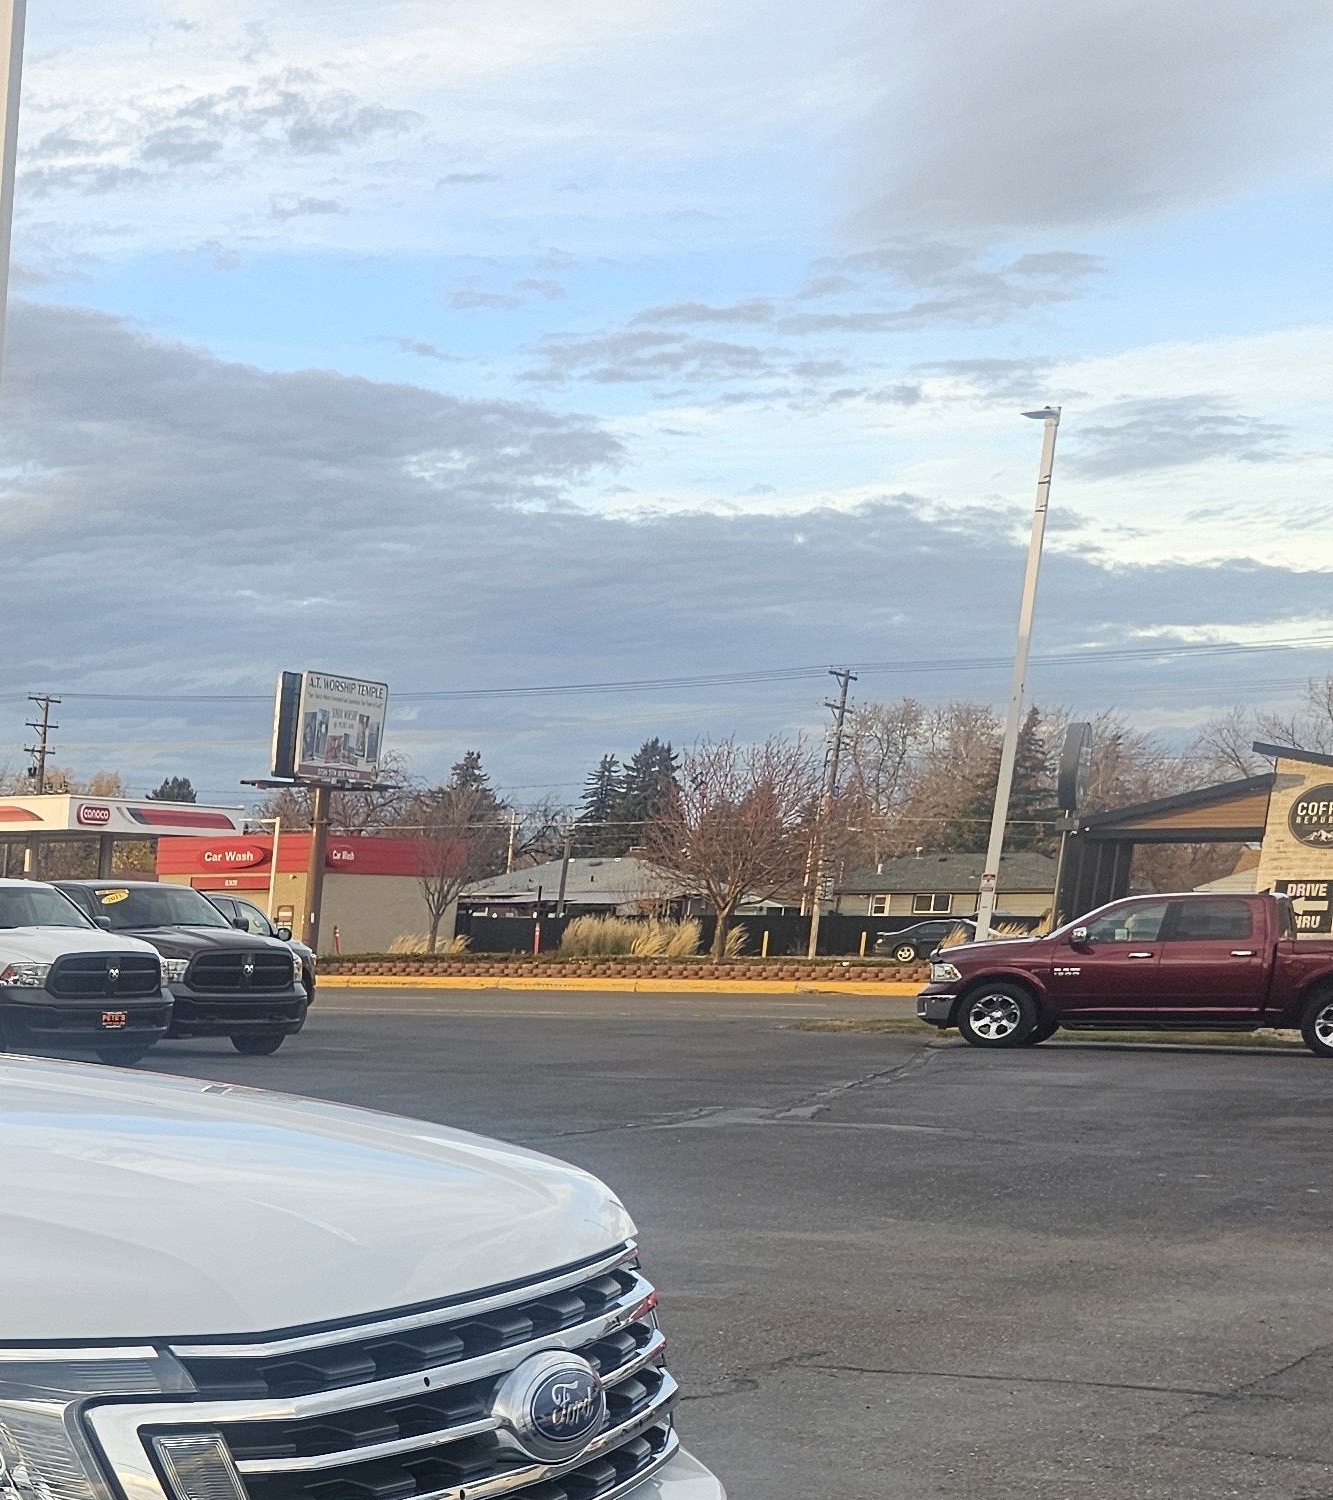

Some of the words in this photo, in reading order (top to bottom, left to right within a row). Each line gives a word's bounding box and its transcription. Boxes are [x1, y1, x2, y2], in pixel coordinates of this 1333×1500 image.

[323, 679, 356, 695] WORSHIP
[358, 684, 384, 700] TEMPLE
[204, 851, 222, 863] Car
[224, 850, 254, 863] Wash
[332, 849, 342, 860] Car
[1286, 883, 1328, 897] DRIVE
[551, 1380, 594, 1426] Ford
